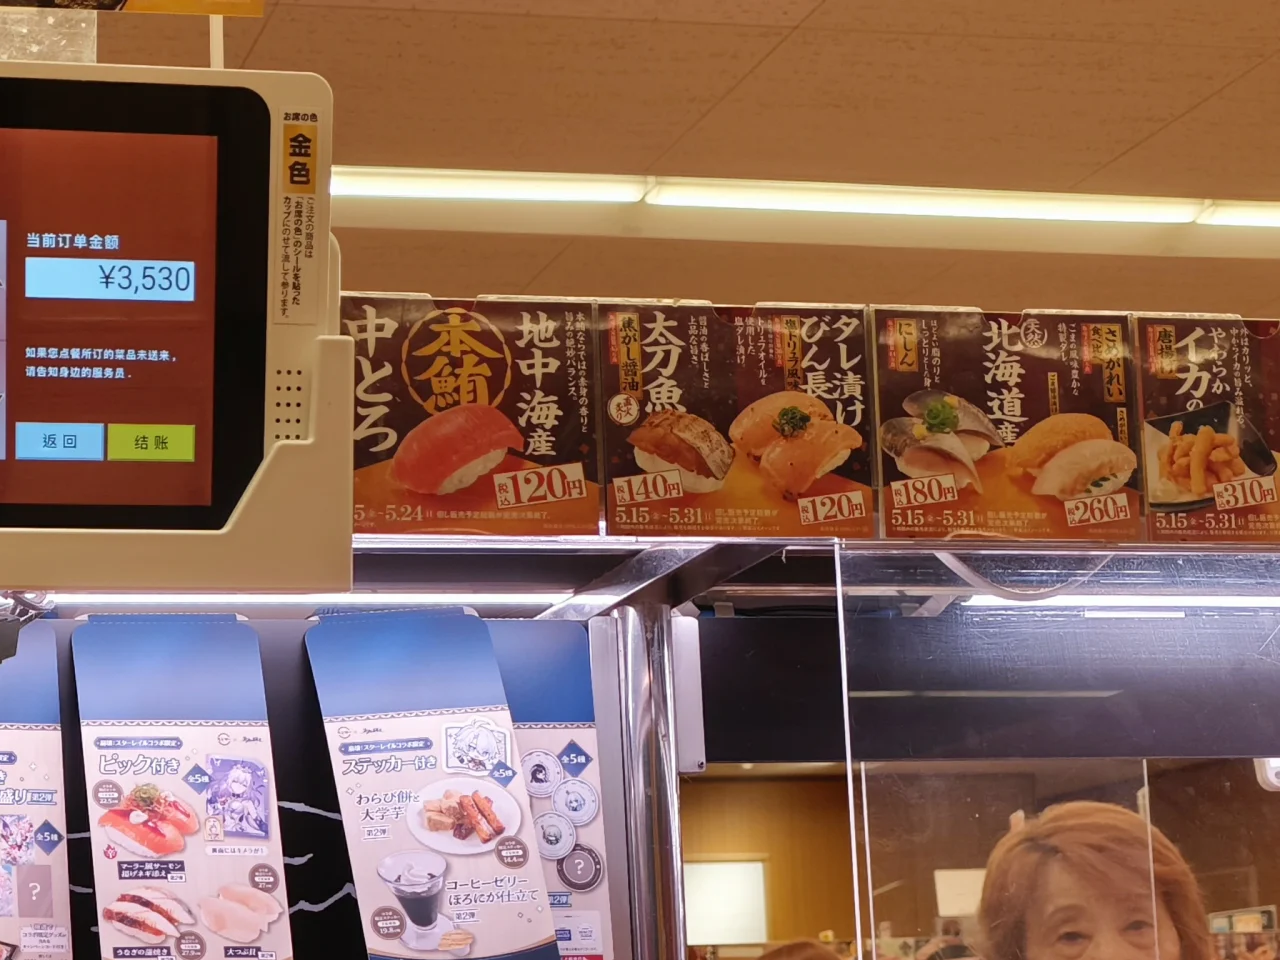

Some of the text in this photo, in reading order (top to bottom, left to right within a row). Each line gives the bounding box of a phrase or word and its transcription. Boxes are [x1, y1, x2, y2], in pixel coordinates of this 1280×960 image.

[283, 112, 318, 122] お席の色
[288, 133, 312, 185] 金色
[26, 232, 119, 250] 当前订单金额
[98, 265, 191, 294] ¥3,530
[619, 316, 640, 392] 焦がし醤油
[799, 315, 837, 400] びん長
[898, 322, 915, 367] にしん
[411, 312, 505, 409] 本鮪
[640, 310, 688, 413] 太刀魚
[832, 315, 865, 426] タレ漬け
[1208, 327, 1231, 395] やわらか
[343, 304, 399, 453] 中とろ
[515, 310, 564, 456] 地中海産
[982, 318, 1029, 446] 北海道産
[42, 433, 77, 449] 返回
[134, 435, 169, 450] 结账
[508, 466, 585, 507] 120円
[624, 473, 682, 501] 140円
[902, 478, 957, 505] 180円
[1223, 480, 1275, 508] 310円
[809, 493, 863, 523] 120円
[1074, 496, 1128, 525] 260円
[99, 753, 181, 775] ピック付き
[342, 755, 437, 775] ステッカー付き
[561, 753, 587, 764] 全5種
[356, 790, 420, 806] わらび餅と
[360, 806, 405, 822] 大学芋
[446, 878, 528, 891] コーヒーゼリー
[448, 890, 539, 905] ほろにが仕立て
